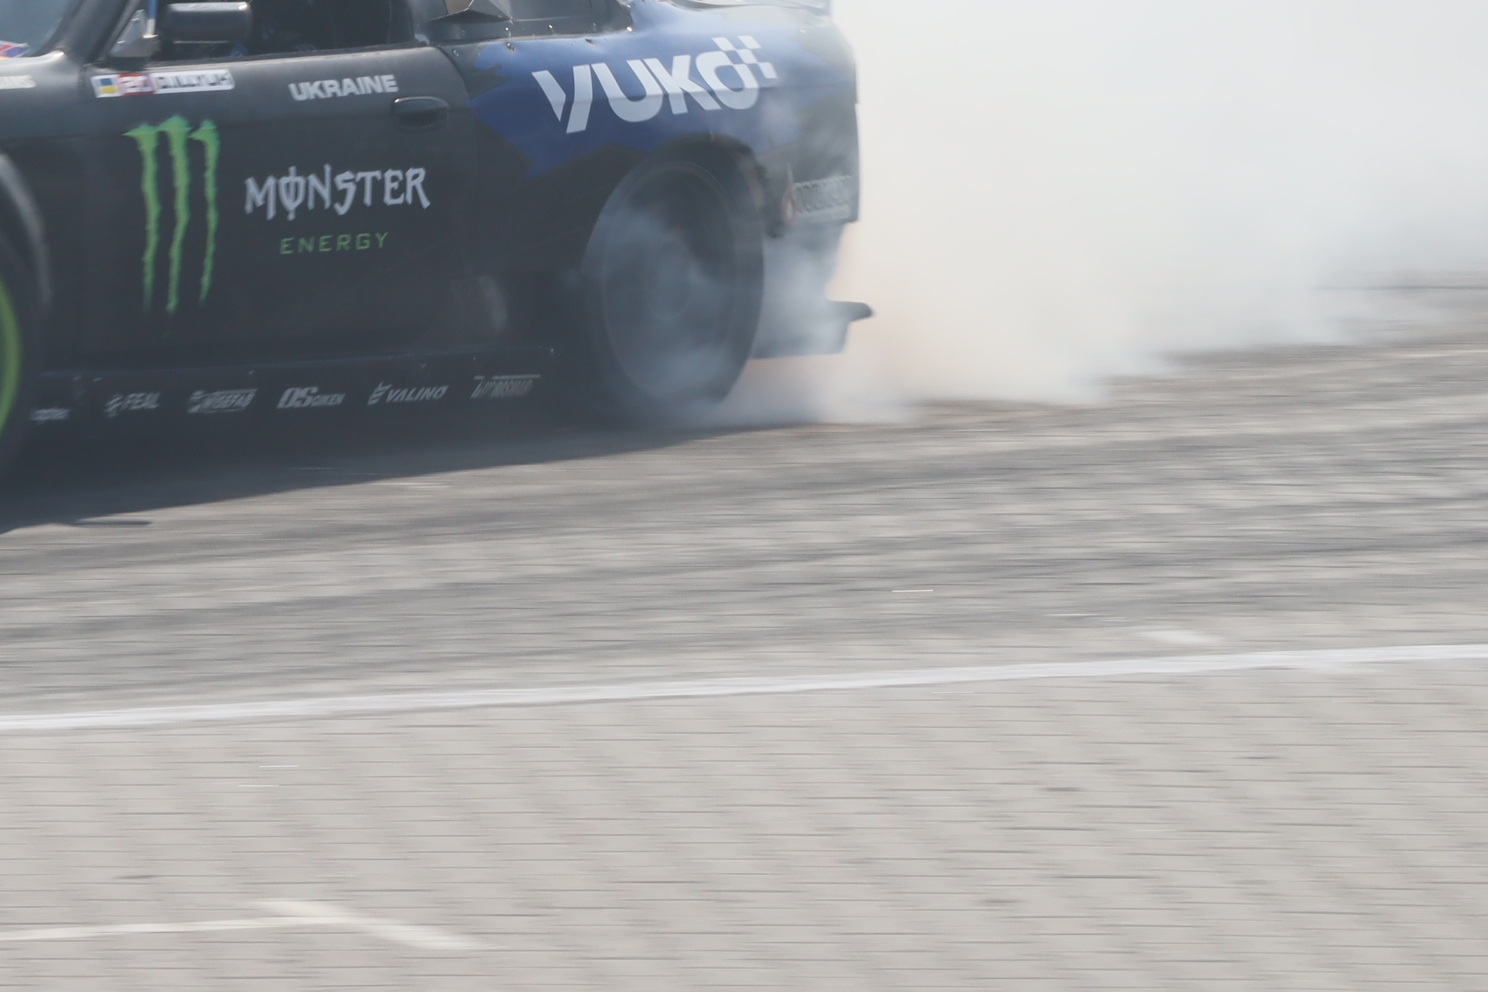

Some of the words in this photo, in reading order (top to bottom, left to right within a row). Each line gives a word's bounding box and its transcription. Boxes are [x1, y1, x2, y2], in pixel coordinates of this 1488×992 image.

[288, 74, 399, 101] UKRAINE
[531, 36, 778, 134] YUKO
[244, 163, 430, 221] MONSTER
[280, 231, 389, 255] ENERGY
[386, 384, 449, 403] VALINO
